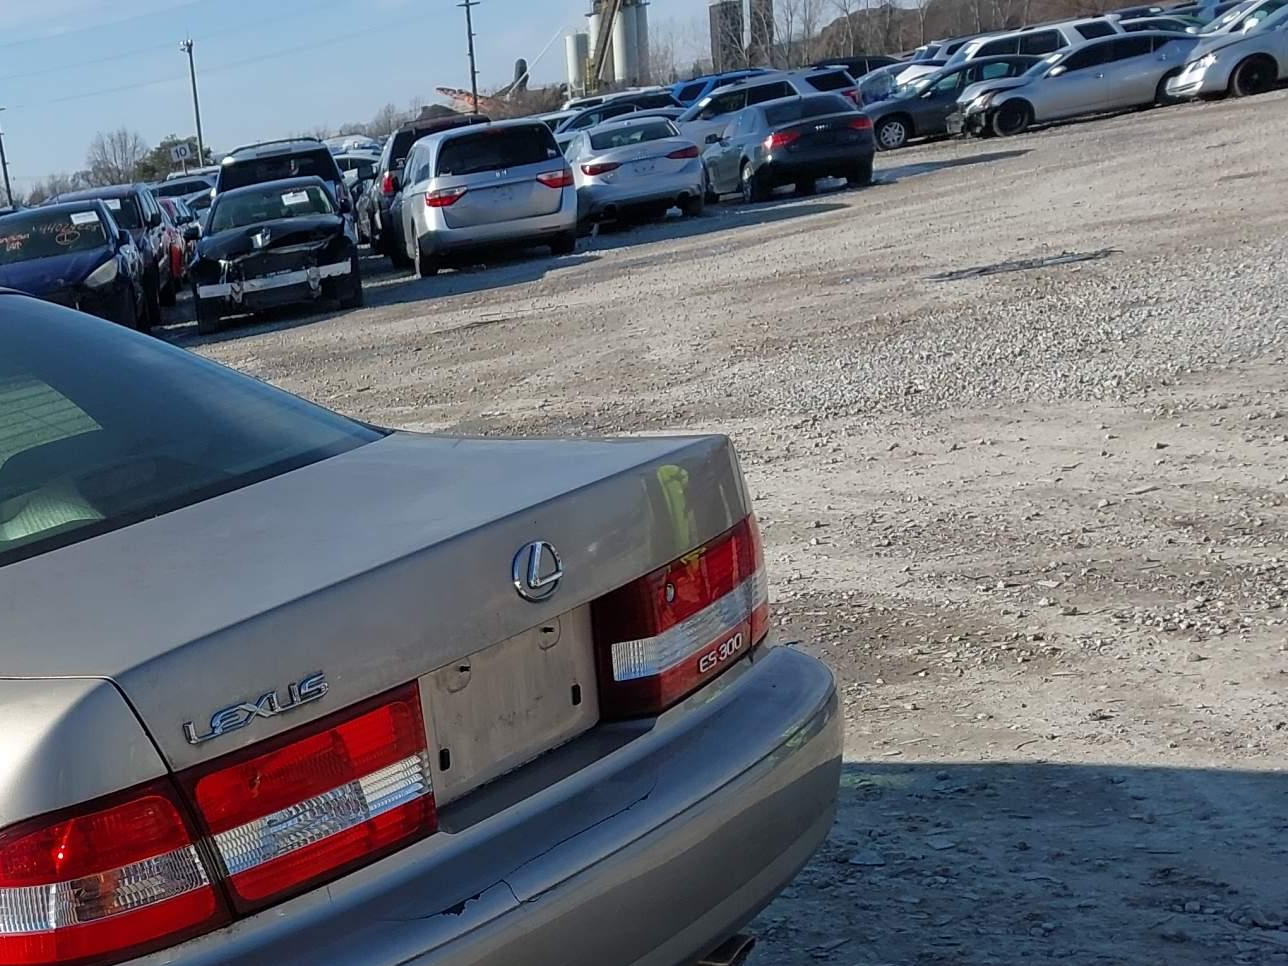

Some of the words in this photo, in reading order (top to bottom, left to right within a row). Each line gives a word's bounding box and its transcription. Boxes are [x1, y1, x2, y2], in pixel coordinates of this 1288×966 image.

[174, 146, 187, 158] 10
[699, 650, 718, 673] ES
[718, 632, 742, 661] 300
[183, 670, 329, 744] LEXUS
